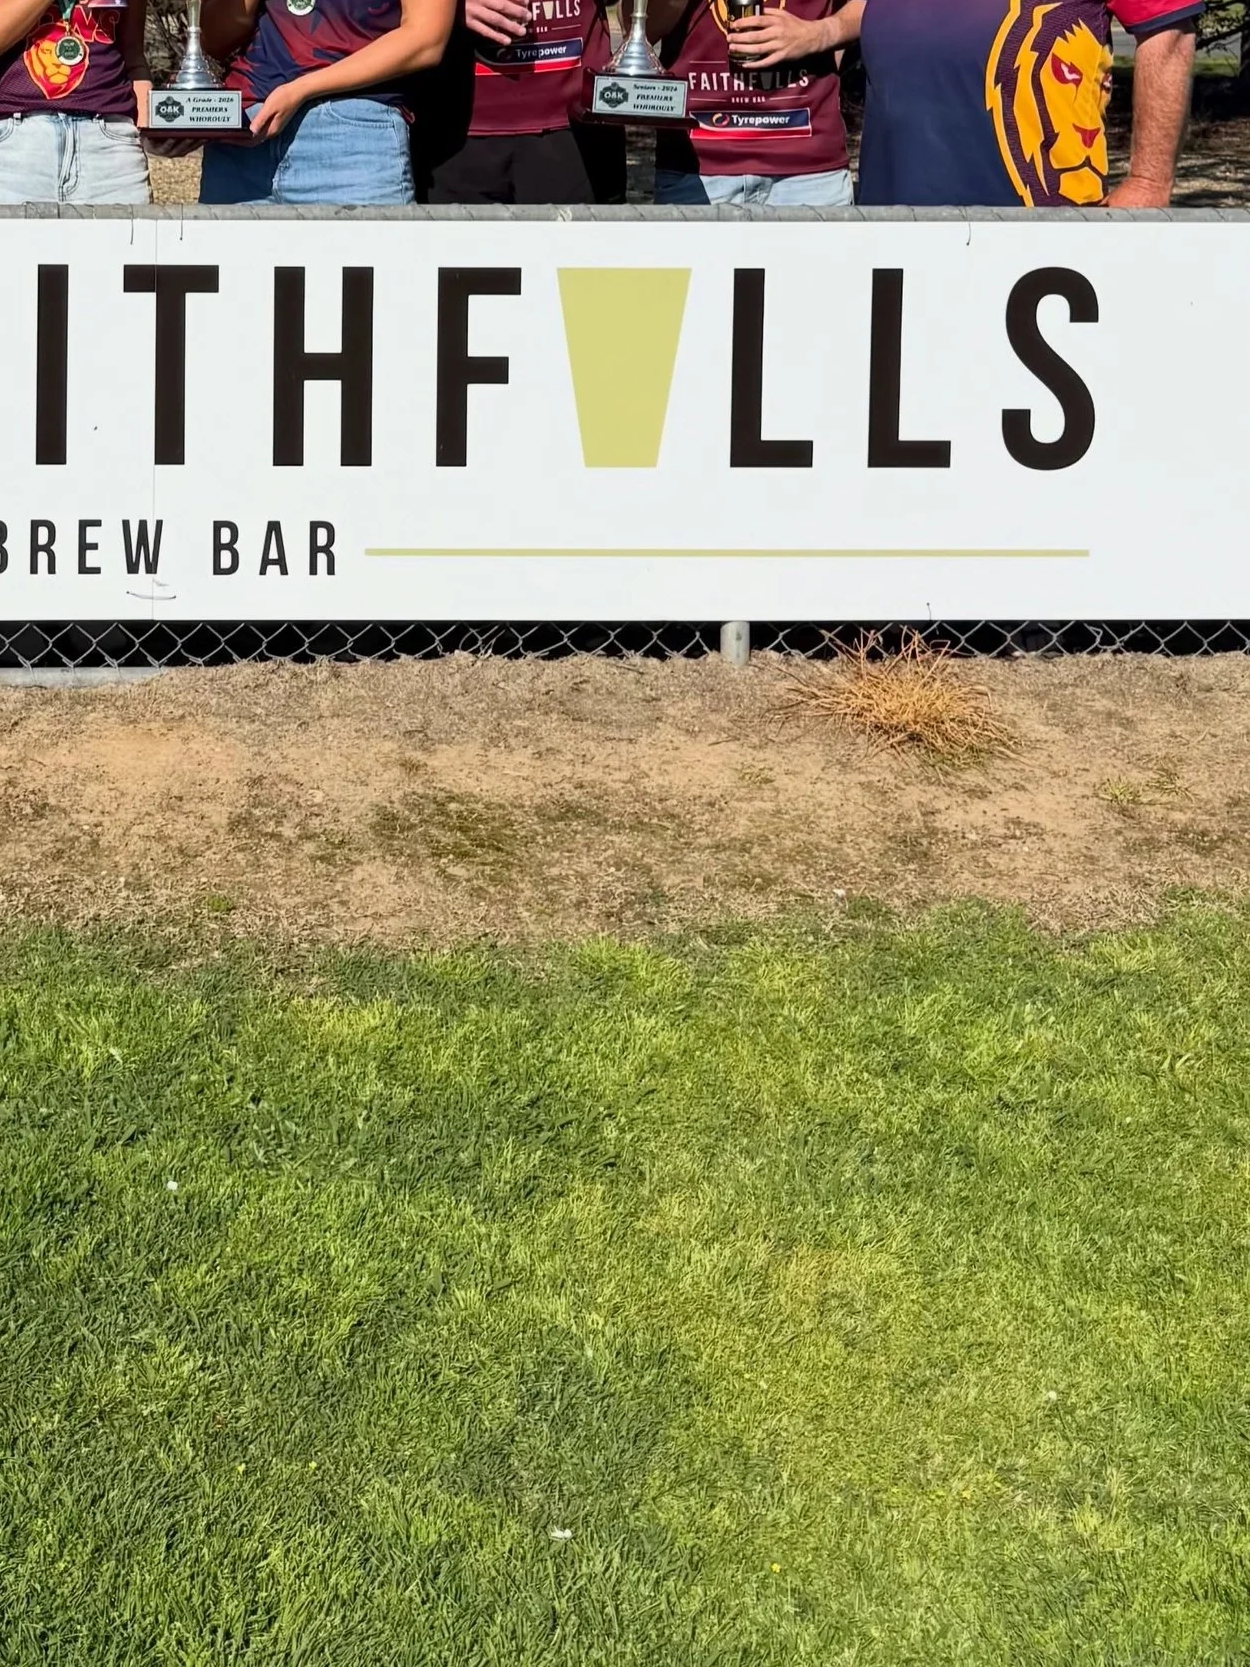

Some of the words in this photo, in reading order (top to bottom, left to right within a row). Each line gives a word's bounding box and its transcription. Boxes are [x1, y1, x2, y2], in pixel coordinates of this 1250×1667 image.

[516, 45, 567, 60] Tyrepower
[731, 114, 790, 126] Tyrepower
[212, 520, 336, 576] BAR
